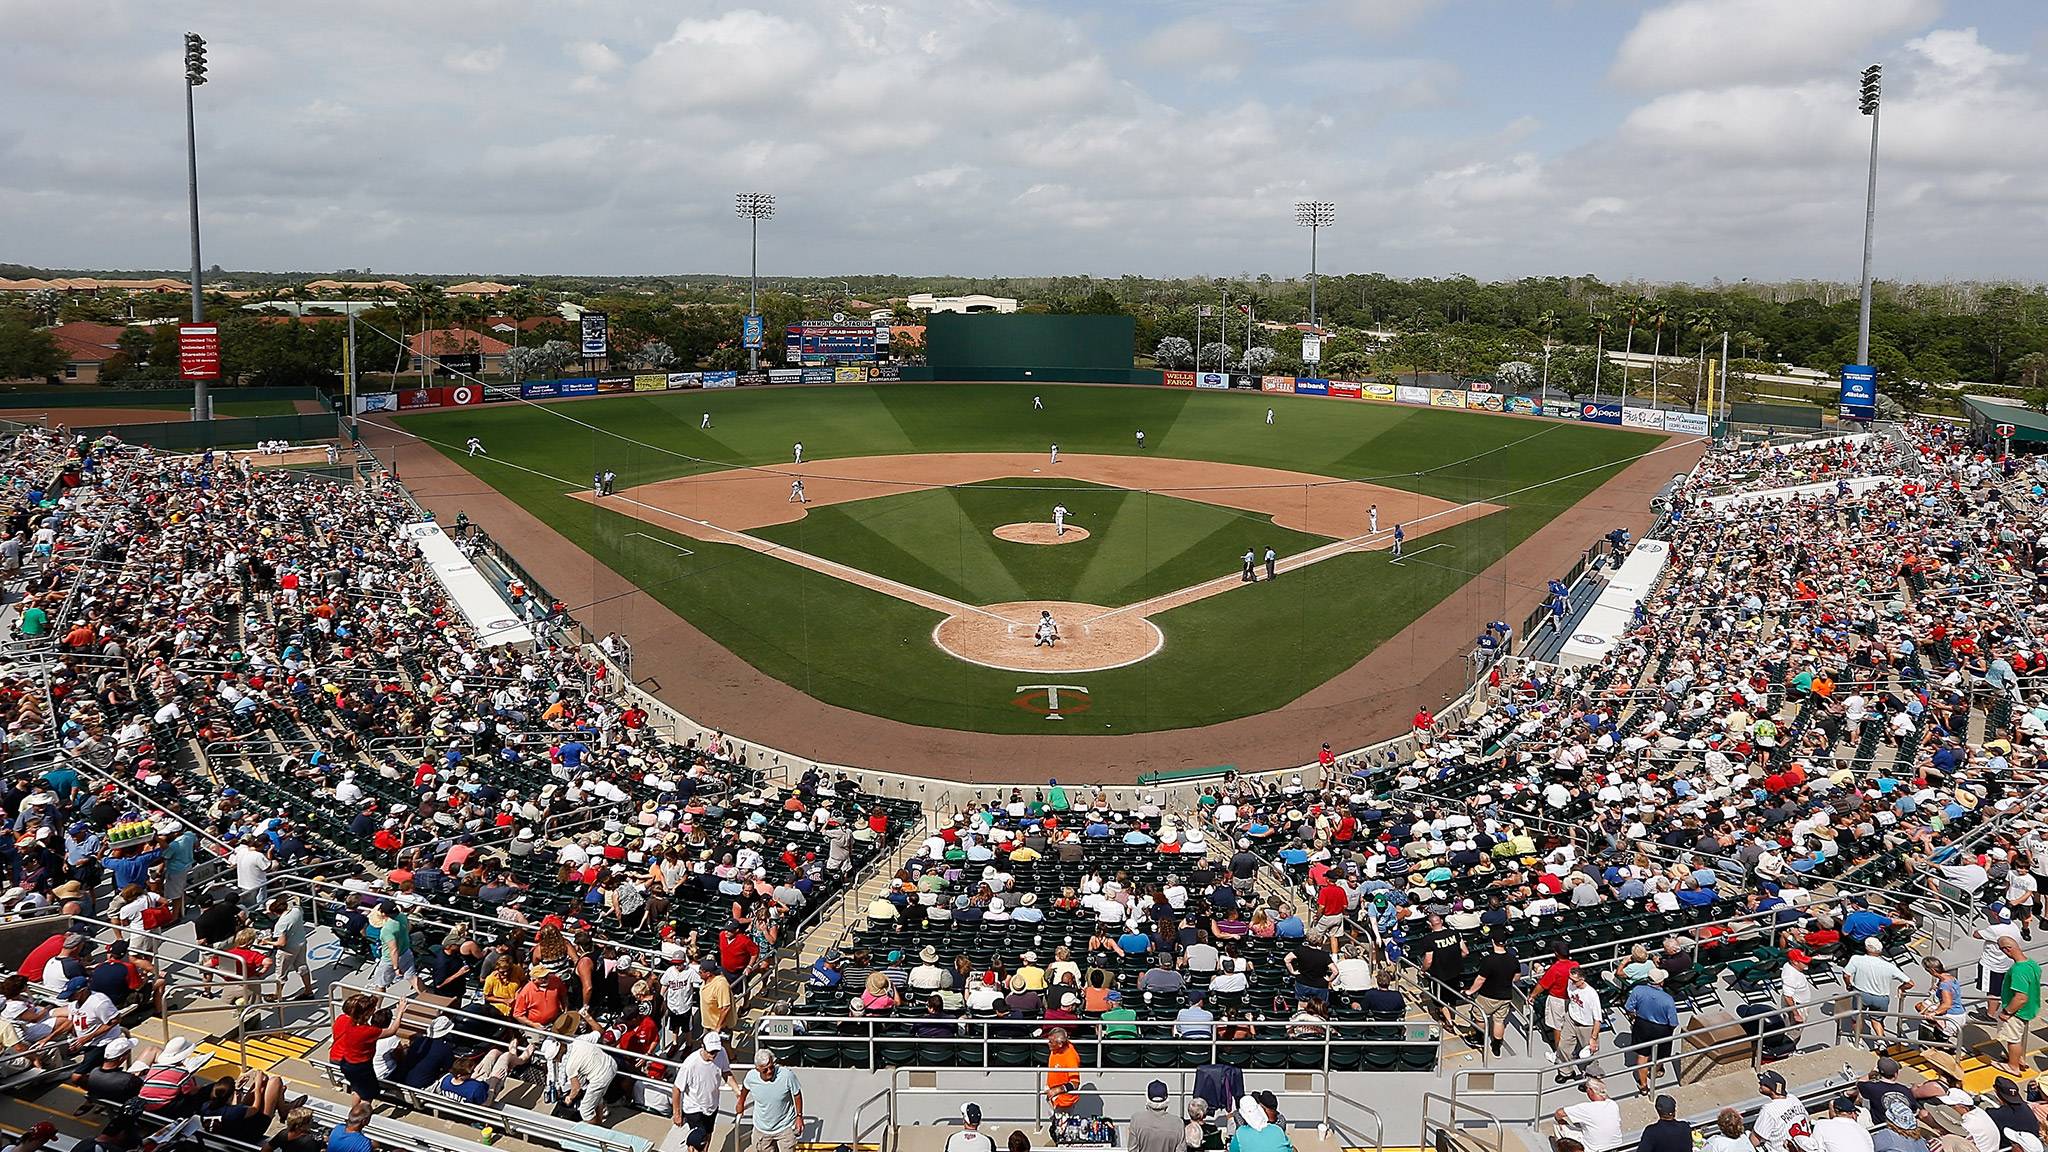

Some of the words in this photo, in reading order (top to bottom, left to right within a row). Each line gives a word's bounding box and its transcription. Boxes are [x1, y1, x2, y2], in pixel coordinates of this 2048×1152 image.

[1598, 409, 1621, 418] pepsi
[739, 856, 748, 867] 7
[1434, 935, 1457, 949] TEAM
[774, 1024, 789, 1034] 108
